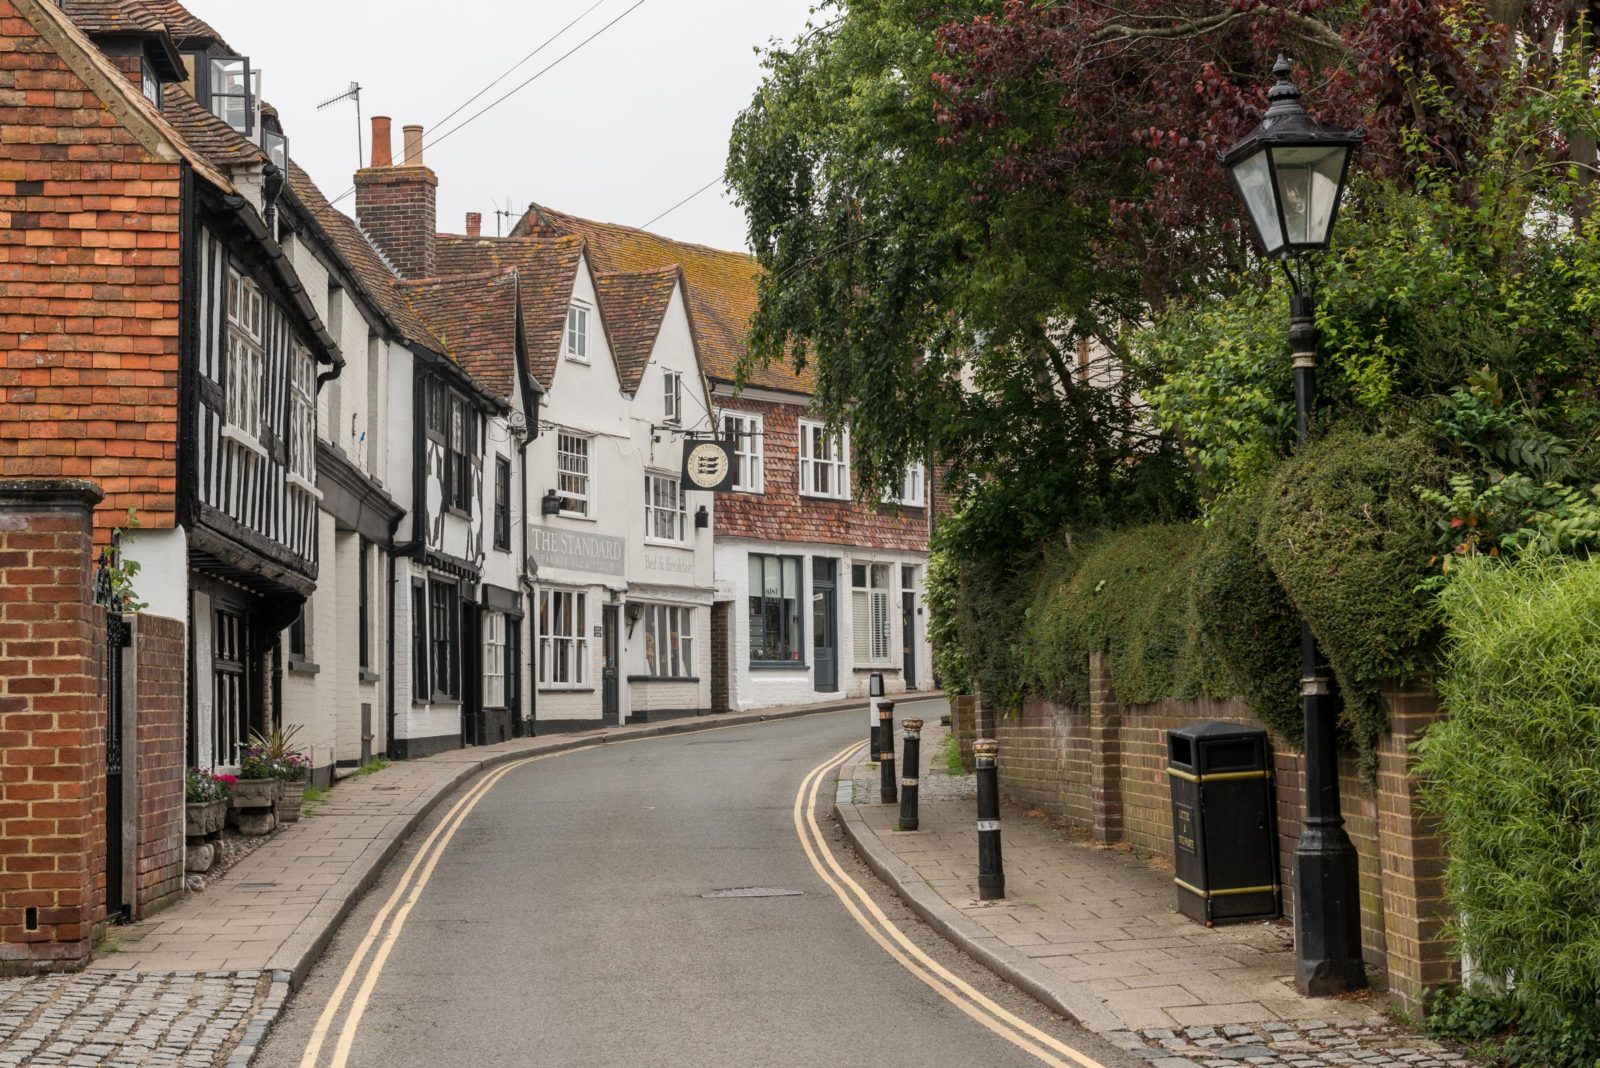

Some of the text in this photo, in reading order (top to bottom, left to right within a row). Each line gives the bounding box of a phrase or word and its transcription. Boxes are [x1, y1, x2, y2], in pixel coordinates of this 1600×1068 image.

[531, 528, 622, 560] THE STANDARD
[644, 554, 694, 574] Bed & Breakfast
